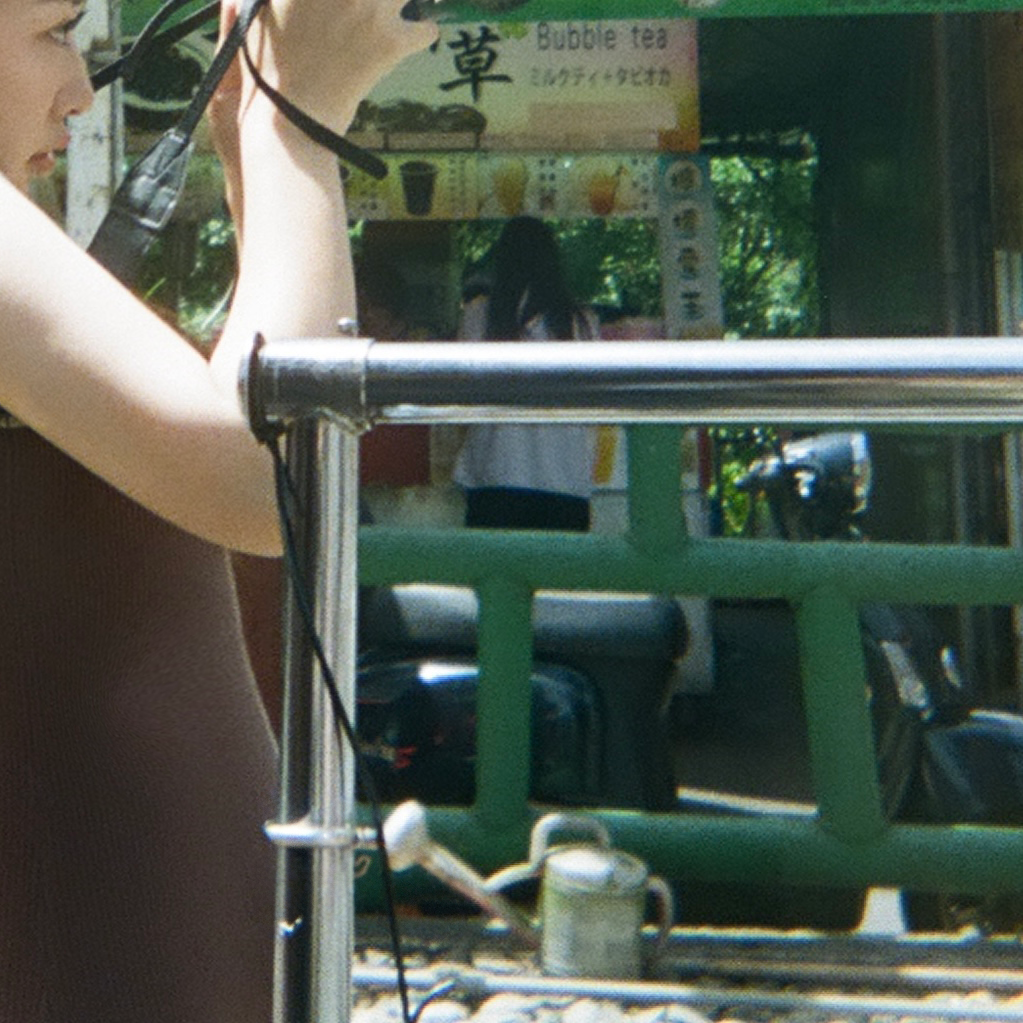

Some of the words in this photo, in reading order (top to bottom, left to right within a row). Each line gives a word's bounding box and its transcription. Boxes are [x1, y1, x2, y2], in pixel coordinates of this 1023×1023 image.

[537, 21, 617, 50] Bubble
[631, 25, 668, 50] tea
[431, 24, 513, 103] 草
